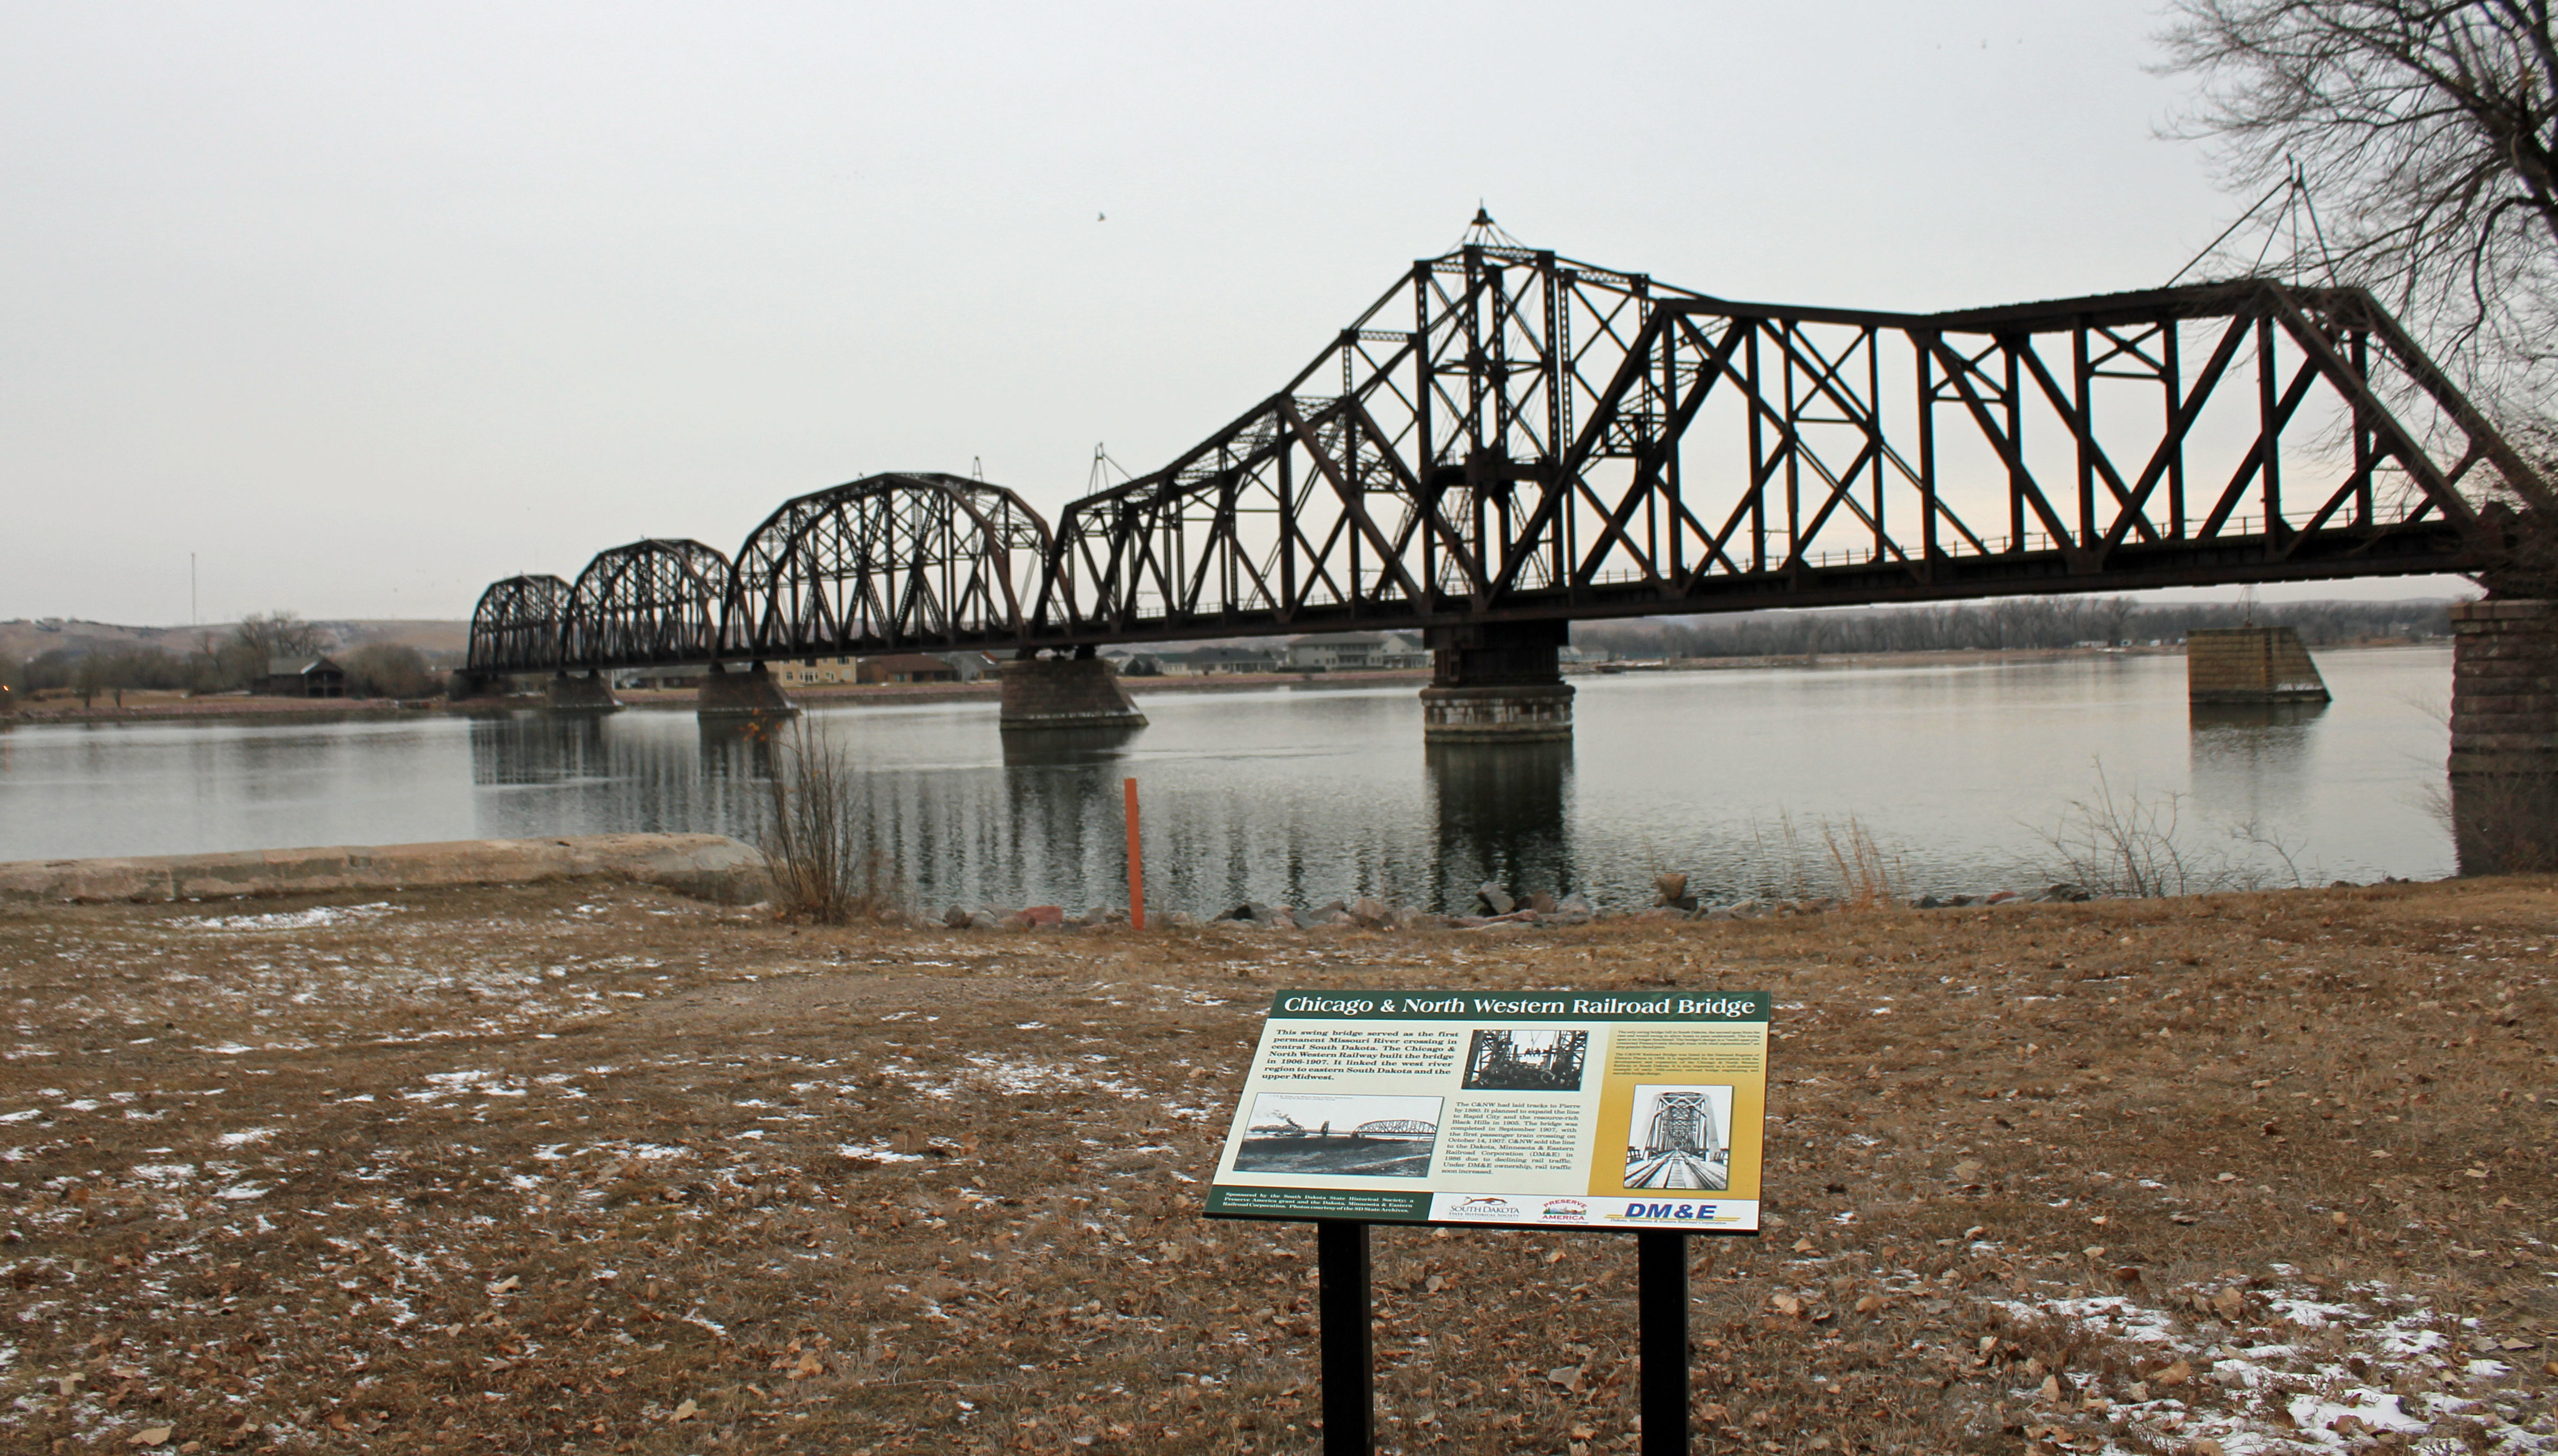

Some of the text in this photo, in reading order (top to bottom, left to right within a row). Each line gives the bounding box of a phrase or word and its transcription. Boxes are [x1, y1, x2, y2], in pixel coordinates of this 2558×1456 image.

[1284, 996, 1755, 1017] Chicago & North Western Railroad Bridge
[1543, 1199, 1587, 1209] PRESERVE
[1624, 1203, 1717, 1219] DM&E
